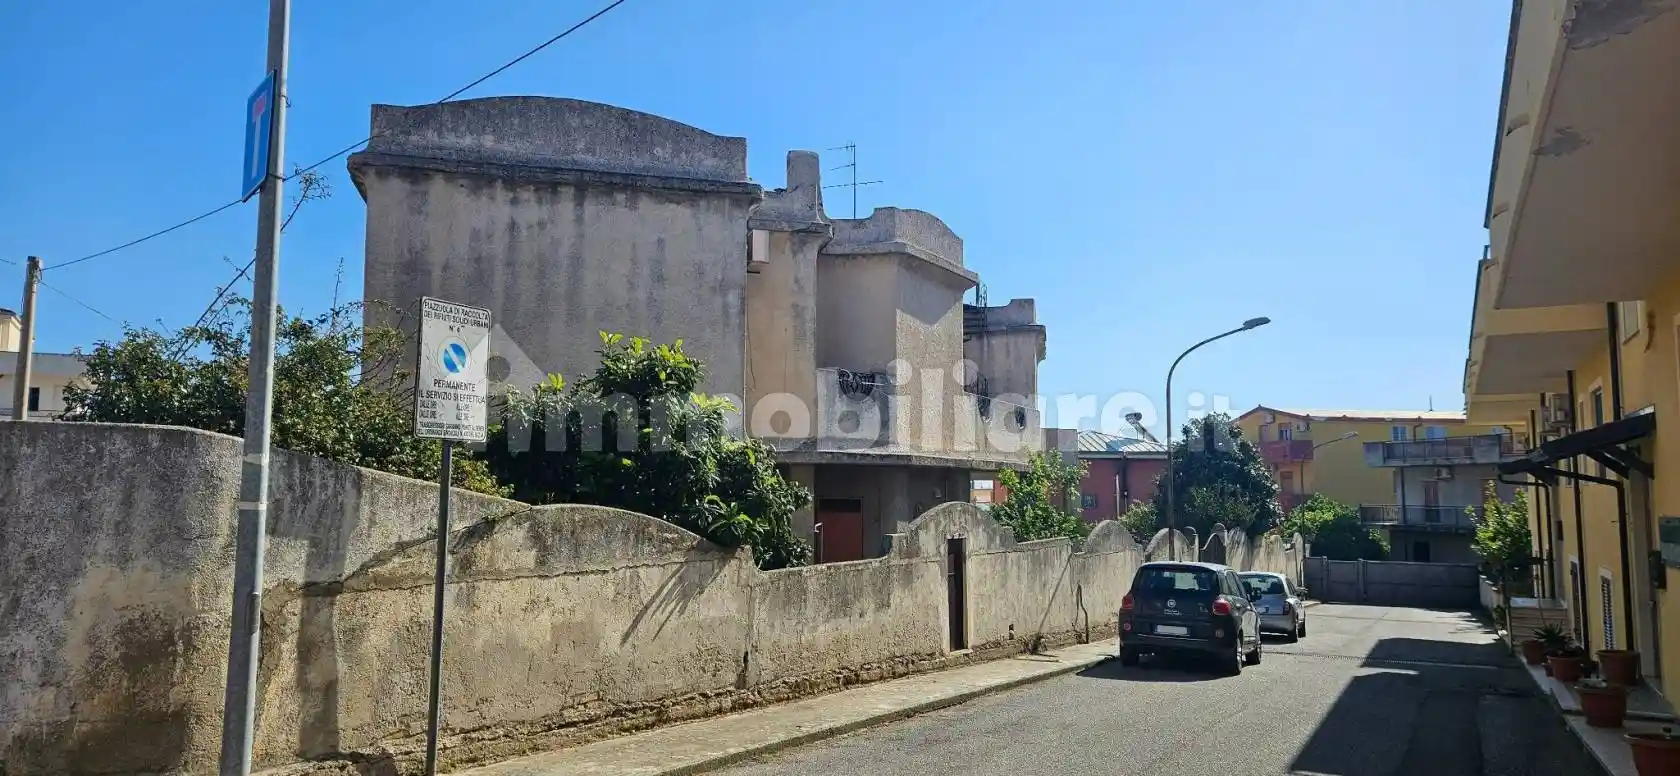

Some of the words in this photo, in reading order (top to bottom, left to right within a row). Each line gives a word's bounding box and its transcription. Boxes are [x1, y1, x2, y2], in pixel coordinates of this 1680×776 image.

[461, 308, 488, 320] RACCOLTA
[433, 378, 476, 392] PERMANENTE
[418, 389, 424, 398] IL
[425, 390, 452, 401] SERVIZIO
[453, 394, 459, 402] SI
